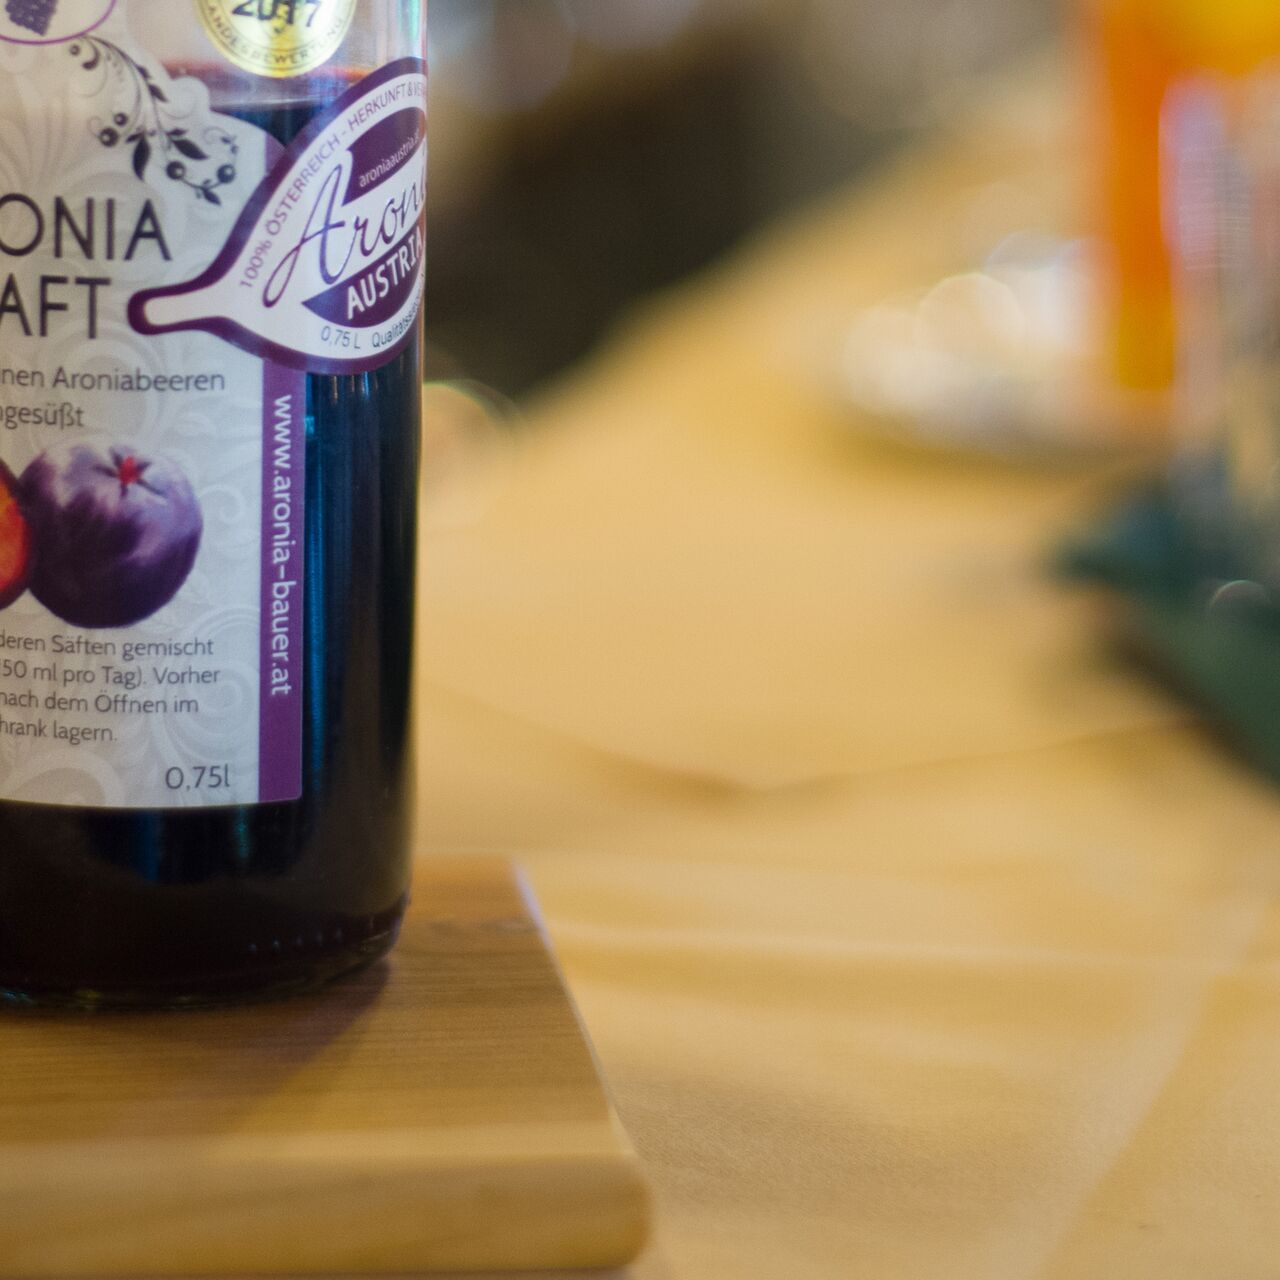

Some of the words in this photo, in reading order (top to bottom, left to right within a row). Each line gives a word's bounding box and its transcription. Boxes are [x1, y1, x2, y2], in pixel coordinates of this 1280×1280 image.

[239, 239, 272, 288] 100%
[265, 134, 341, 236] ÖSTERREICH
[348, 83, 406, 131] HERKUNFT
[320, 325, 351, 348] 0,75
[353, 332, 361, 350] L
[51, 366, 226, 392] Aroniabeeren
[271, 394, 297, 697] www.aronia-bauer.at
[51, 634, 117, 656] Säften
[121, 637, 215, 662] gemischt
[33, 662, 58, 682] ml
[63, 669, 96, 688] pro
[101, 665, 148, 690] Tag).
[152, 665, 221, 685] Vorher
[44, 691, 88, 712] dem
[94, 689, 168, 714] Öffnen
[173, 695, 199, 713] im
[52, 719, 118, 746] lagern.
[164, 763, 231, 792] 0,75l
